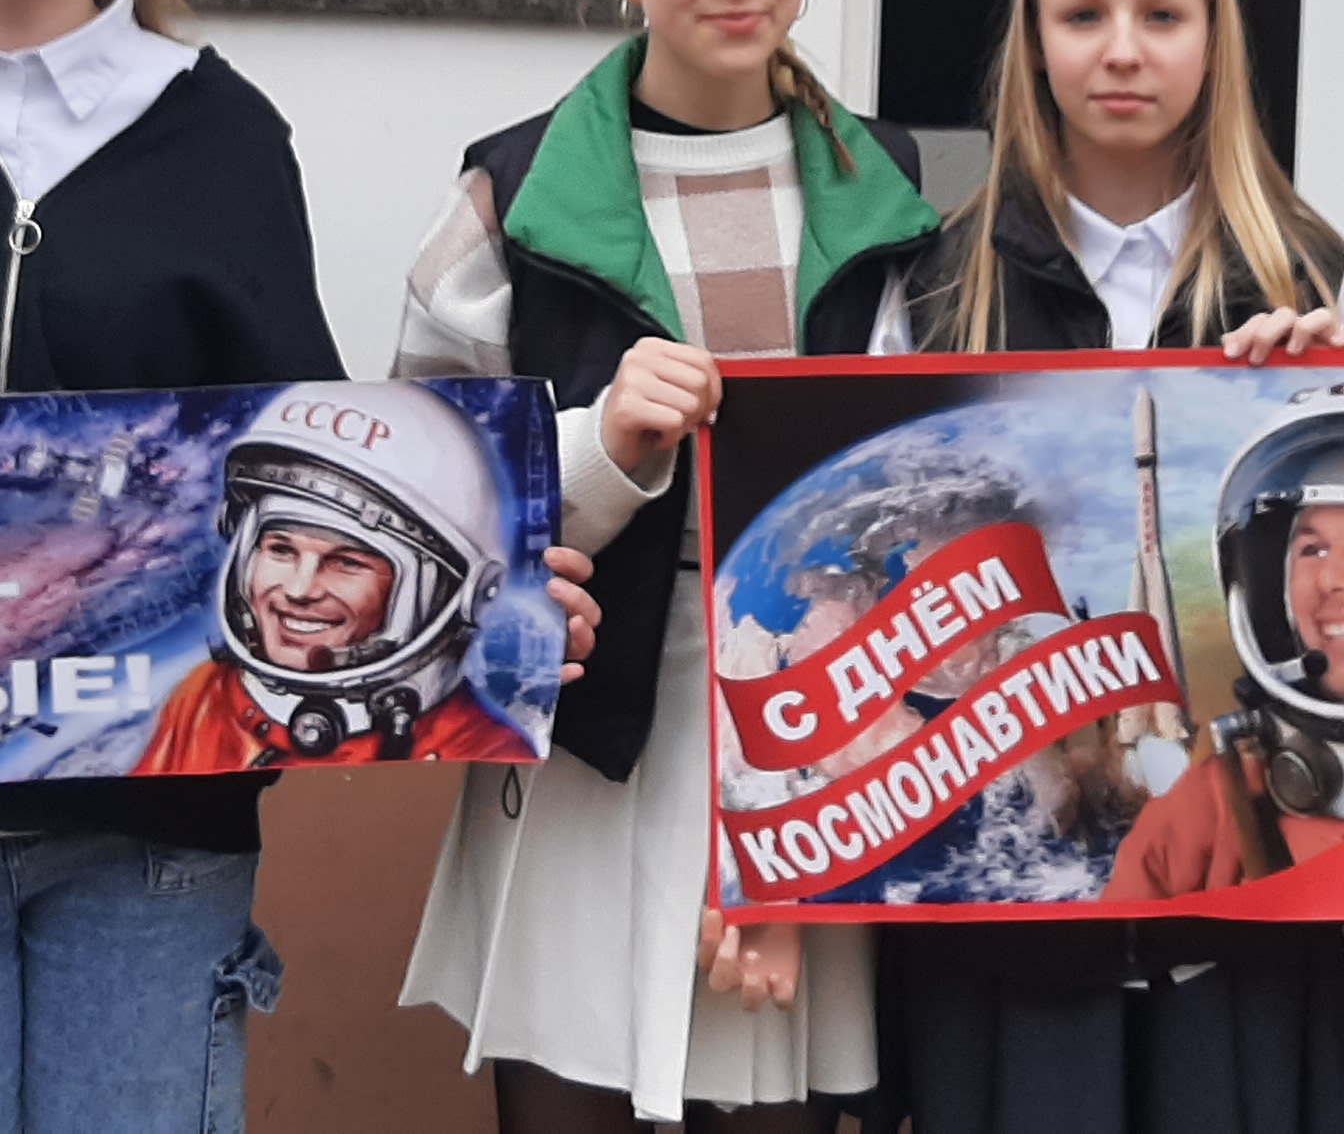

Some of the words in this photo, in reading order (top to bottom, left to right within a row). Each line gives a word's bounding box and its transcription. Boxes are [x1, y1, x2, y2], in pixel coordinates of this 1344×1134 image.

[279, 398, 394, 453] СССР
[761, 690, 819, 742] С
[826, 556, 1022, 723] ДНЁМ
[739, 631, 1162, 884] КОСМОНАВТИКИ
